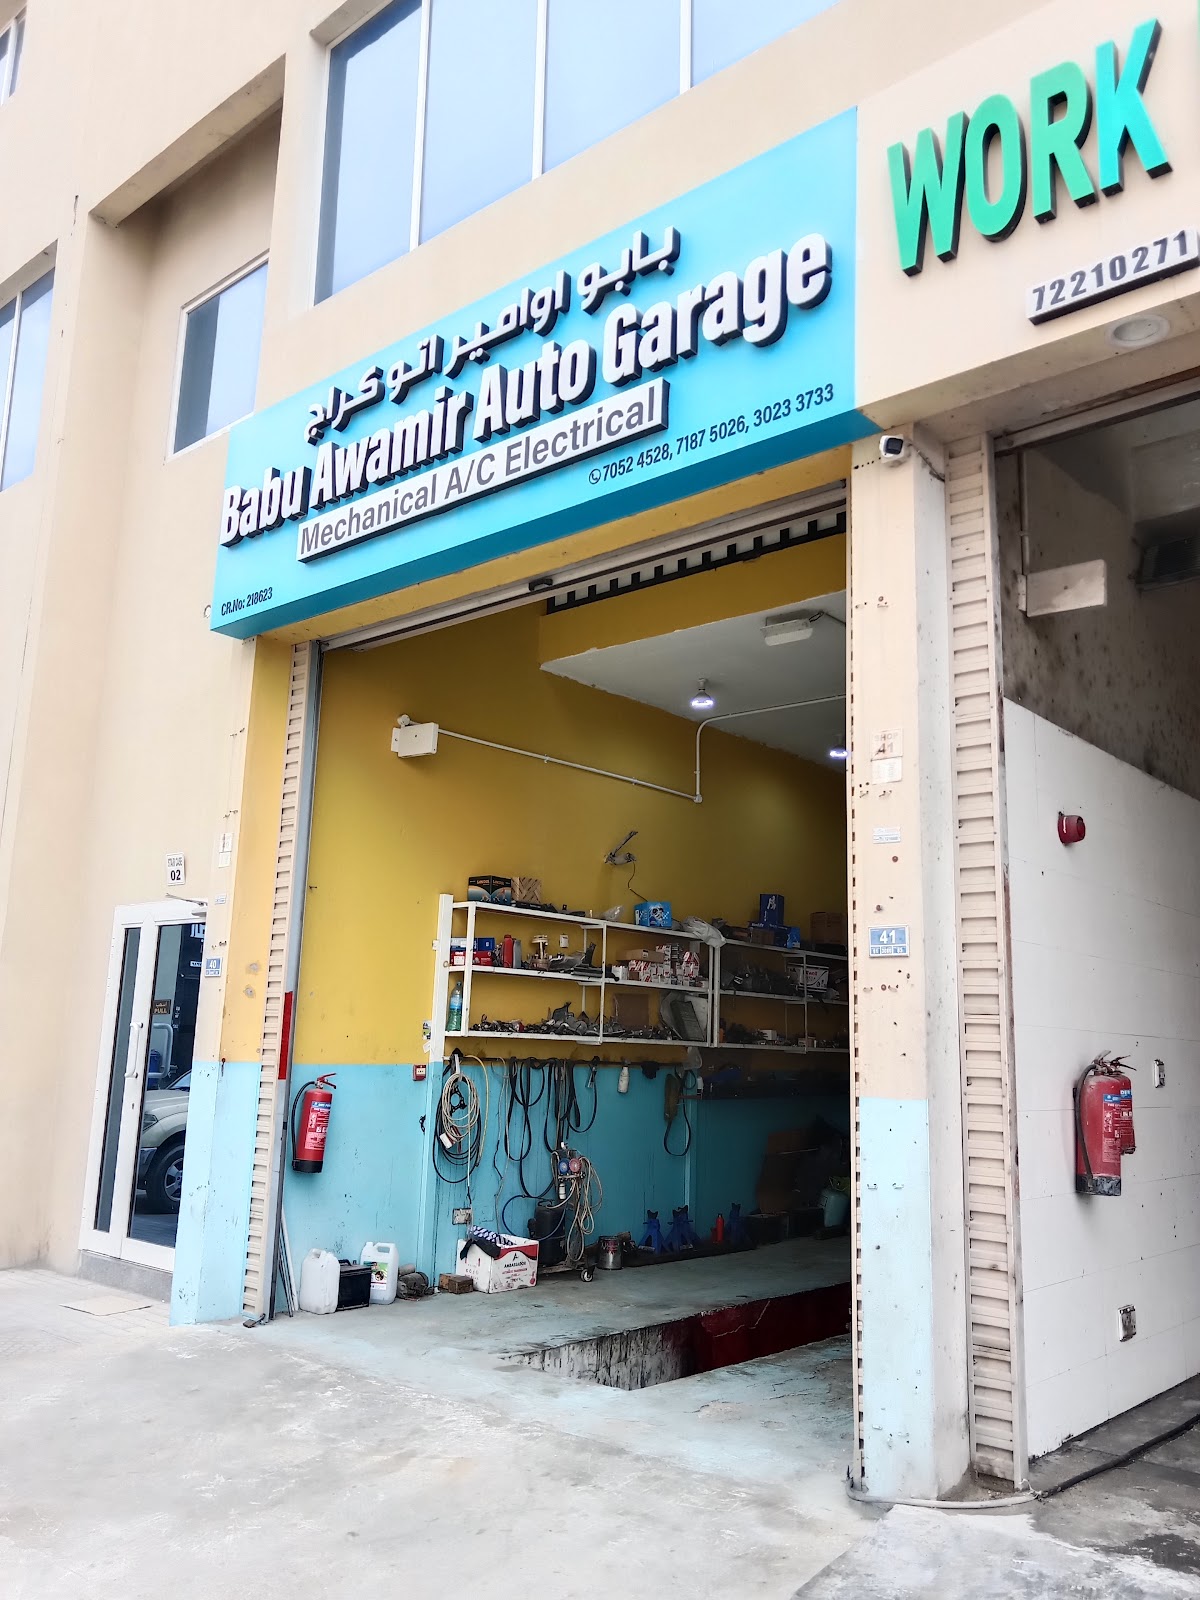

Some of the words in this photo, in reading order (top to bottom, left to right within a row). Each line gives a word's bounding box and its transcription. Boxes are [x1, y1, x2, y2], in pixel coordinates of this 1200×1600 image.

[887, 17, 1171, 276] WORK
[577, 226, 678, 315] بابو
[1032, 229, 1190, 312] 72210271
[220, 465, 309, 547] Babu
[311, 385, 472, 510] Awamir
[473, 340, 595, 443] Auto
[602, 233, 831, 387] Garage
[602, 456, 634, 482] 7052
[636, 443, 673, 470] 4528,
[676, 429, 706, 455] 7187
[709, 415, 750, 443] 5026,
[753, 399, 791, 427] 3023
[795, 383, 834, 413] 3733
[301, 474, 437, 555] Mechanical
[444, 453, 496, 500] A/C
[505, 386, 655, 477] Electrical
[221, 599, 245, 616] CR.No:
[246, 586, 273, 608] 218623
[170, 869, 182, 881] 02
[209, 959, 218, 970] 40
[879, 929, 897, 944] 41
